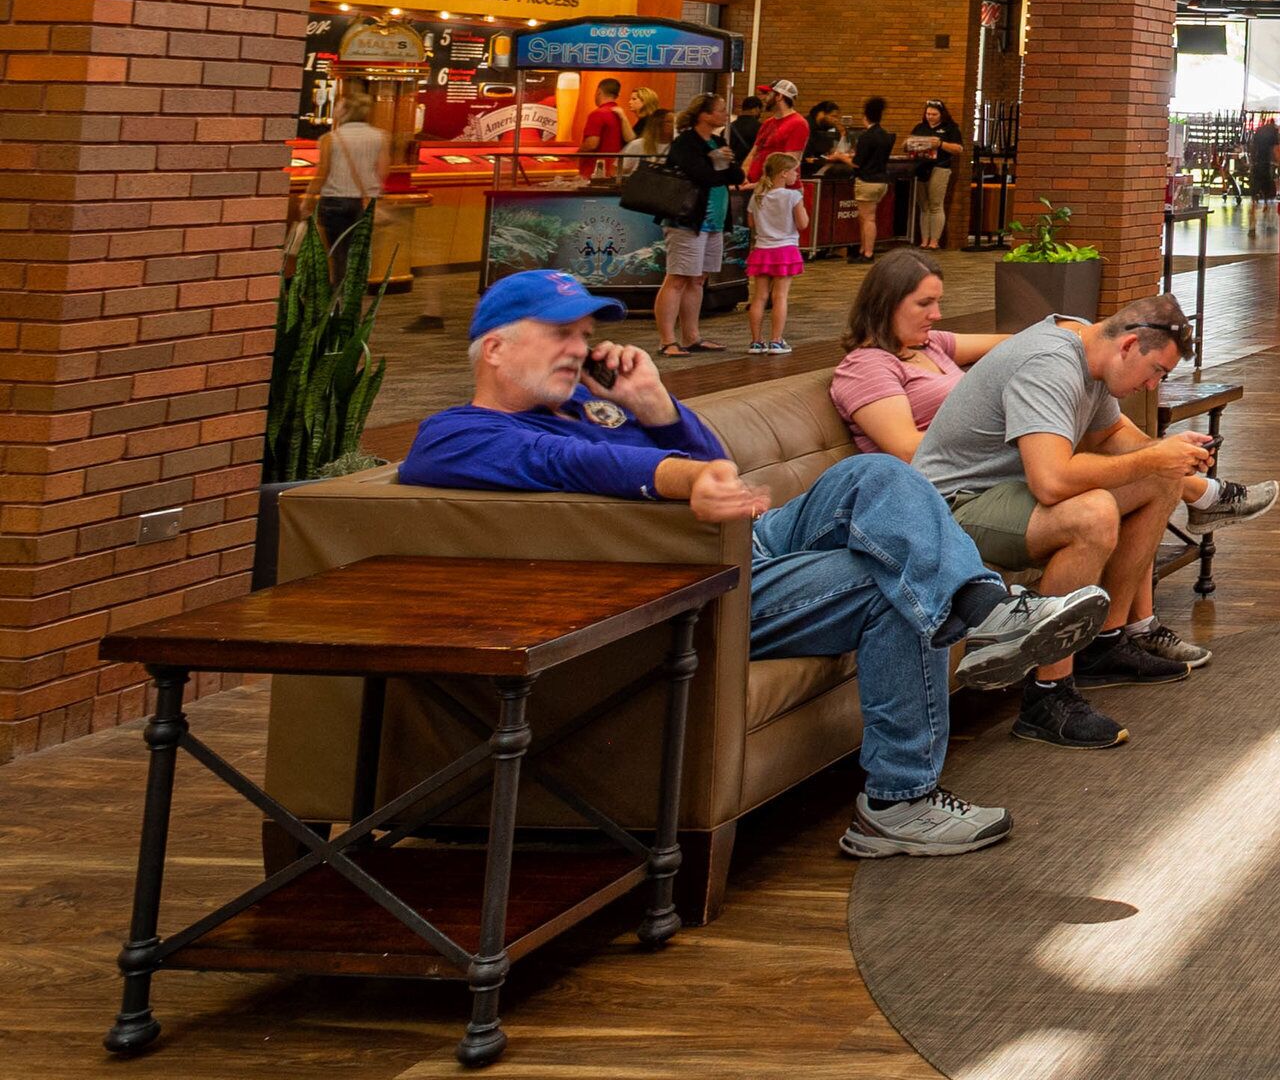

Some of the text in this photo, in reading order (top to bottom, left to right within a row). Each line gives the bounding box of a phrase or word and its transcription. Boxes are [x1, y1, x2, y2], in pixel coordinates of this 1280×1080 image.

[440, 29, 452, 46] 5
[438, 67, 449, 85] 6
[485, 111, 530, 135] Amerin
